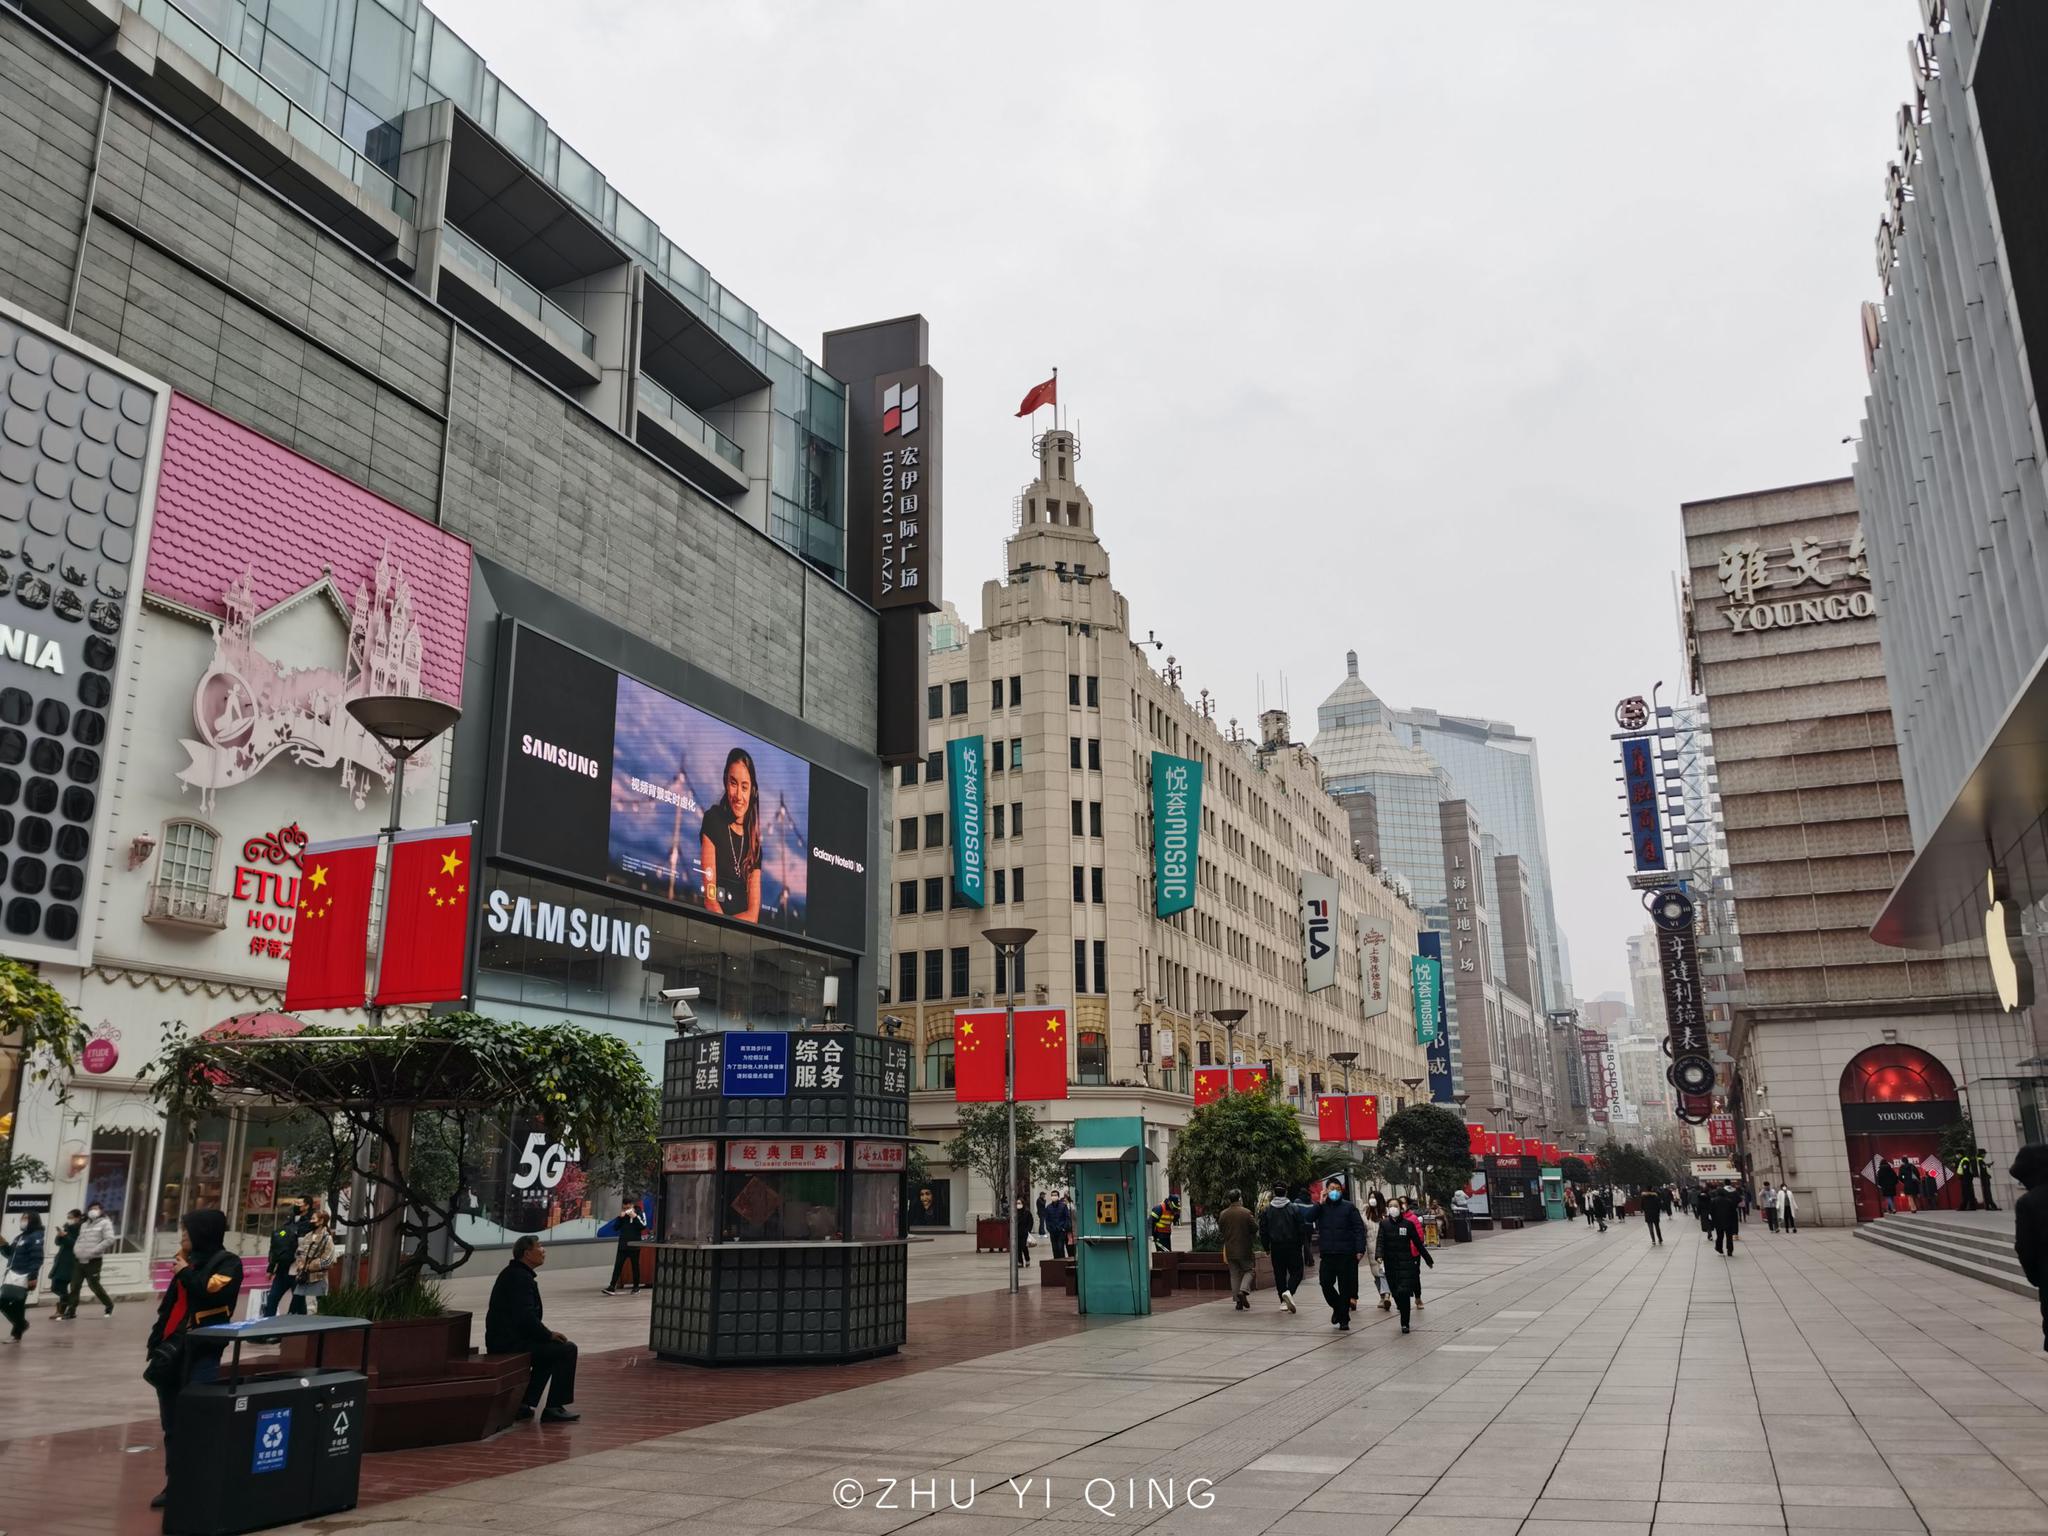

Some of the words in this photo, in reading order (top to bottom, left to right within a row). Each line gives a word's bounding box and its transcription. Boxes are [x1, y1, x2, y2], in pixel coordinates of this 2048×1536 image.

[882, 450, 894, 524] HONGYI
[899, 447, 919, 589] 宏伊国际广场
[881, 532, 893, 594] PLAZA
[522, 734, 599, 779] SAMSUNG
[813, 847, 835, 865] Galaxy
[487, 889, 651, 962] SAMSUNG
[1307, 899, 1331, 960] FILA
[1452, 855, 1474, 972] 上海置地广场
[696, 1040, 721, 1065] 上海
[795, 1039, 844, 1063] 综合
[884, 1046, 907, 1070] 上海
[695, 1066, 719, 1090] 经典
[794, 1064, 844, 1089] 服务
[884, 1070, 906, 1094] 经典
[1606, 1054, 1621, 1114] BOSIDENG
[1877, 1112, 1925, 1121] YOUNGOR
[512, 1132, 567, 1189] 5G
[743, 1145, 828, 1160] 经典国货
